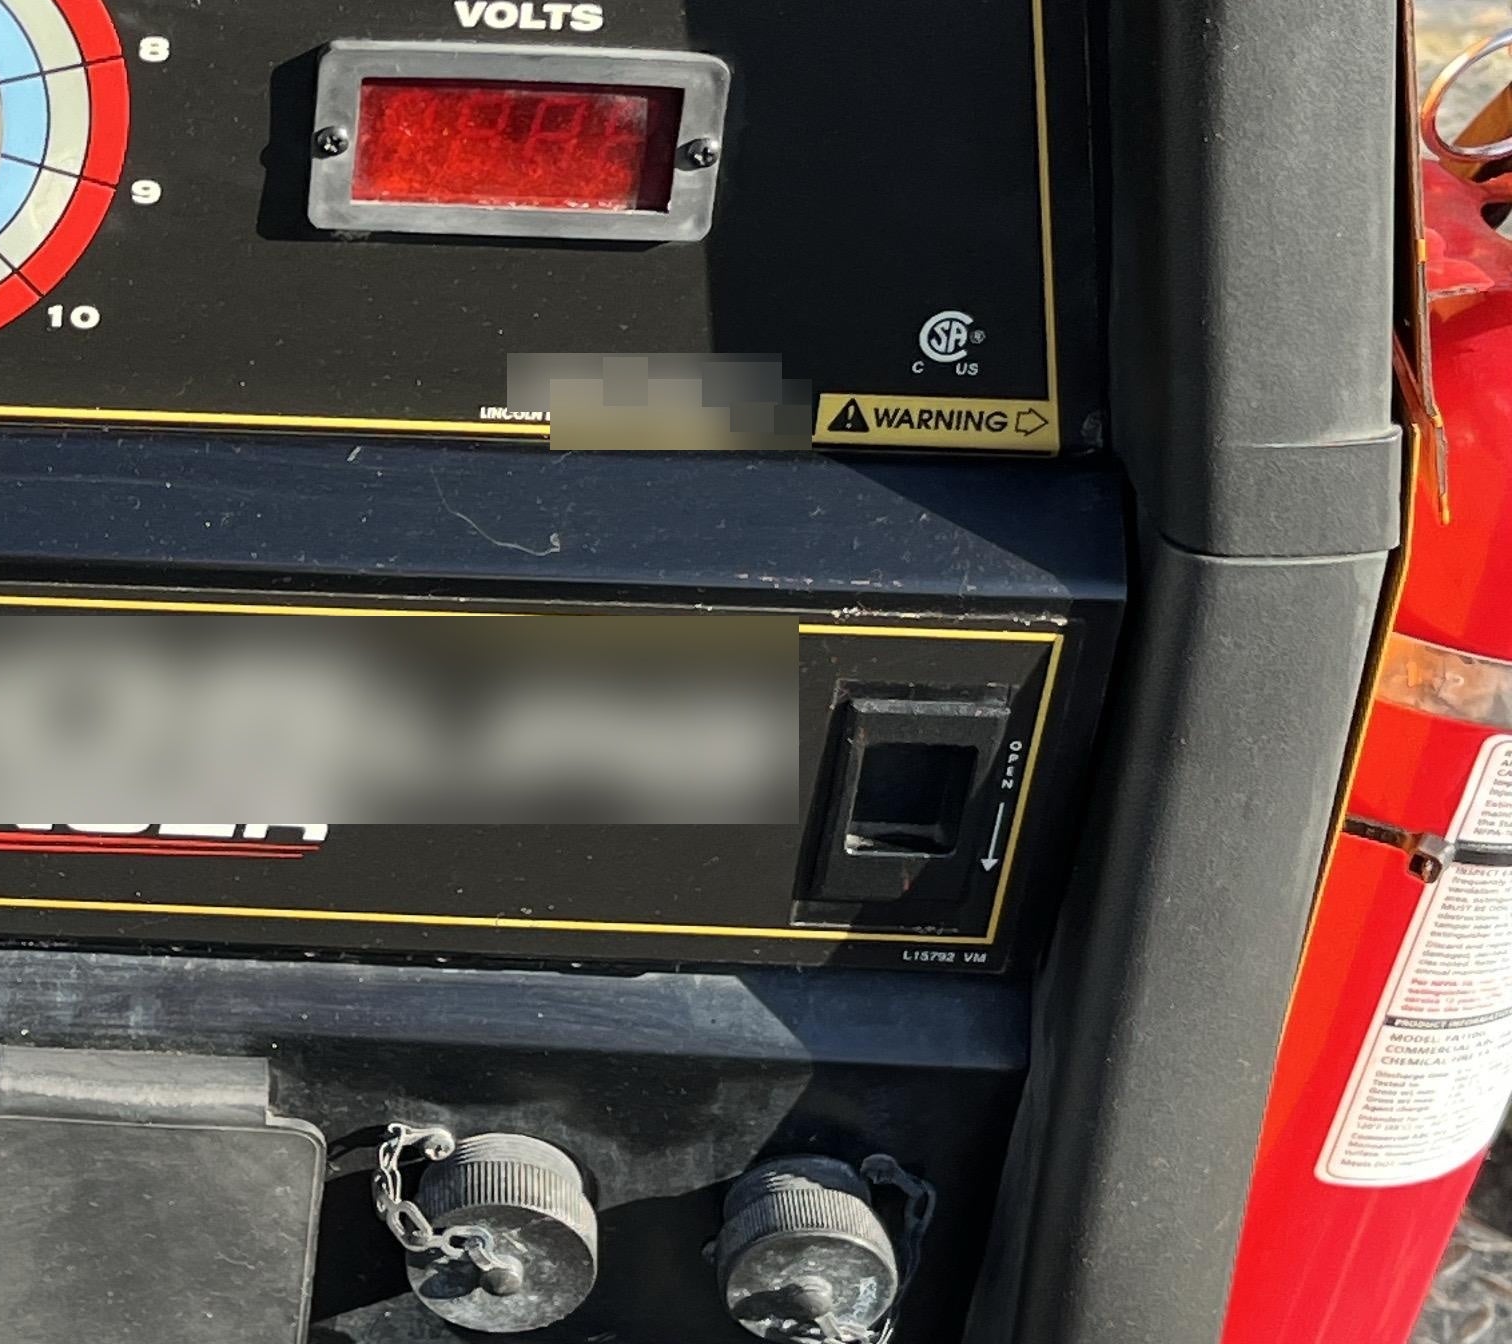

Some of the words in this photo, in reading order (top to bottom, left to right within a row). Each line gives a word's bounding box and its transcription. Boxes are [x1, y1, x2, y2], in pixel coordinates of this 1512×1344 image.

[453, 0, 605, 33] VOLTS
[138, 35, 172, 63] 8
[130, 179, 162, 205] 9
[47, 304, 101, 330] 10
[911, 360, 925, 374] C
[955, 361, 979, 376] US
[872, 406, 1009, 433] WARNING
[964, 951, 987, 964] VM
